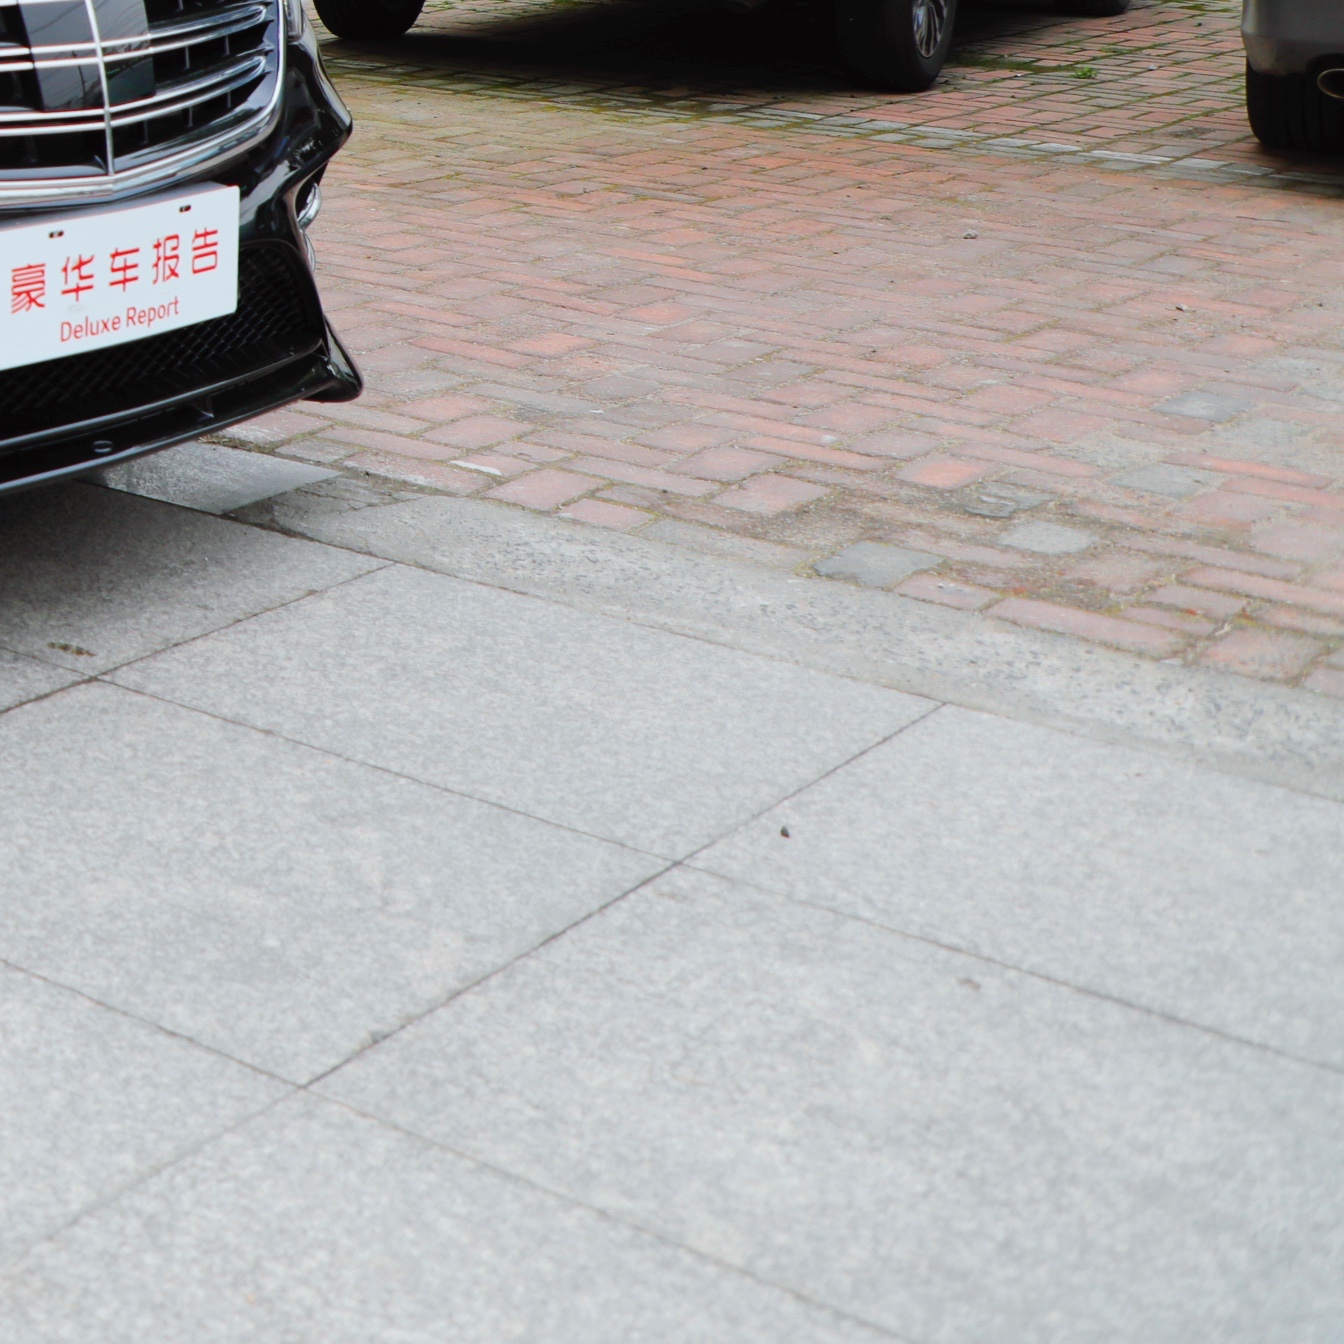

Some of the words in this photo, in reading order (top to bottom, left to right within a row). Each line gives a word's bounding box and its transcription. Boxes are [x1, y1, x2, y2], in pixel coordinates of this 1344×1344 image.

[11, 227, 219, 314] 豪华车报告
[60, 315, 121, 342] Deluxe
[126, 295, 179, 327] Report
